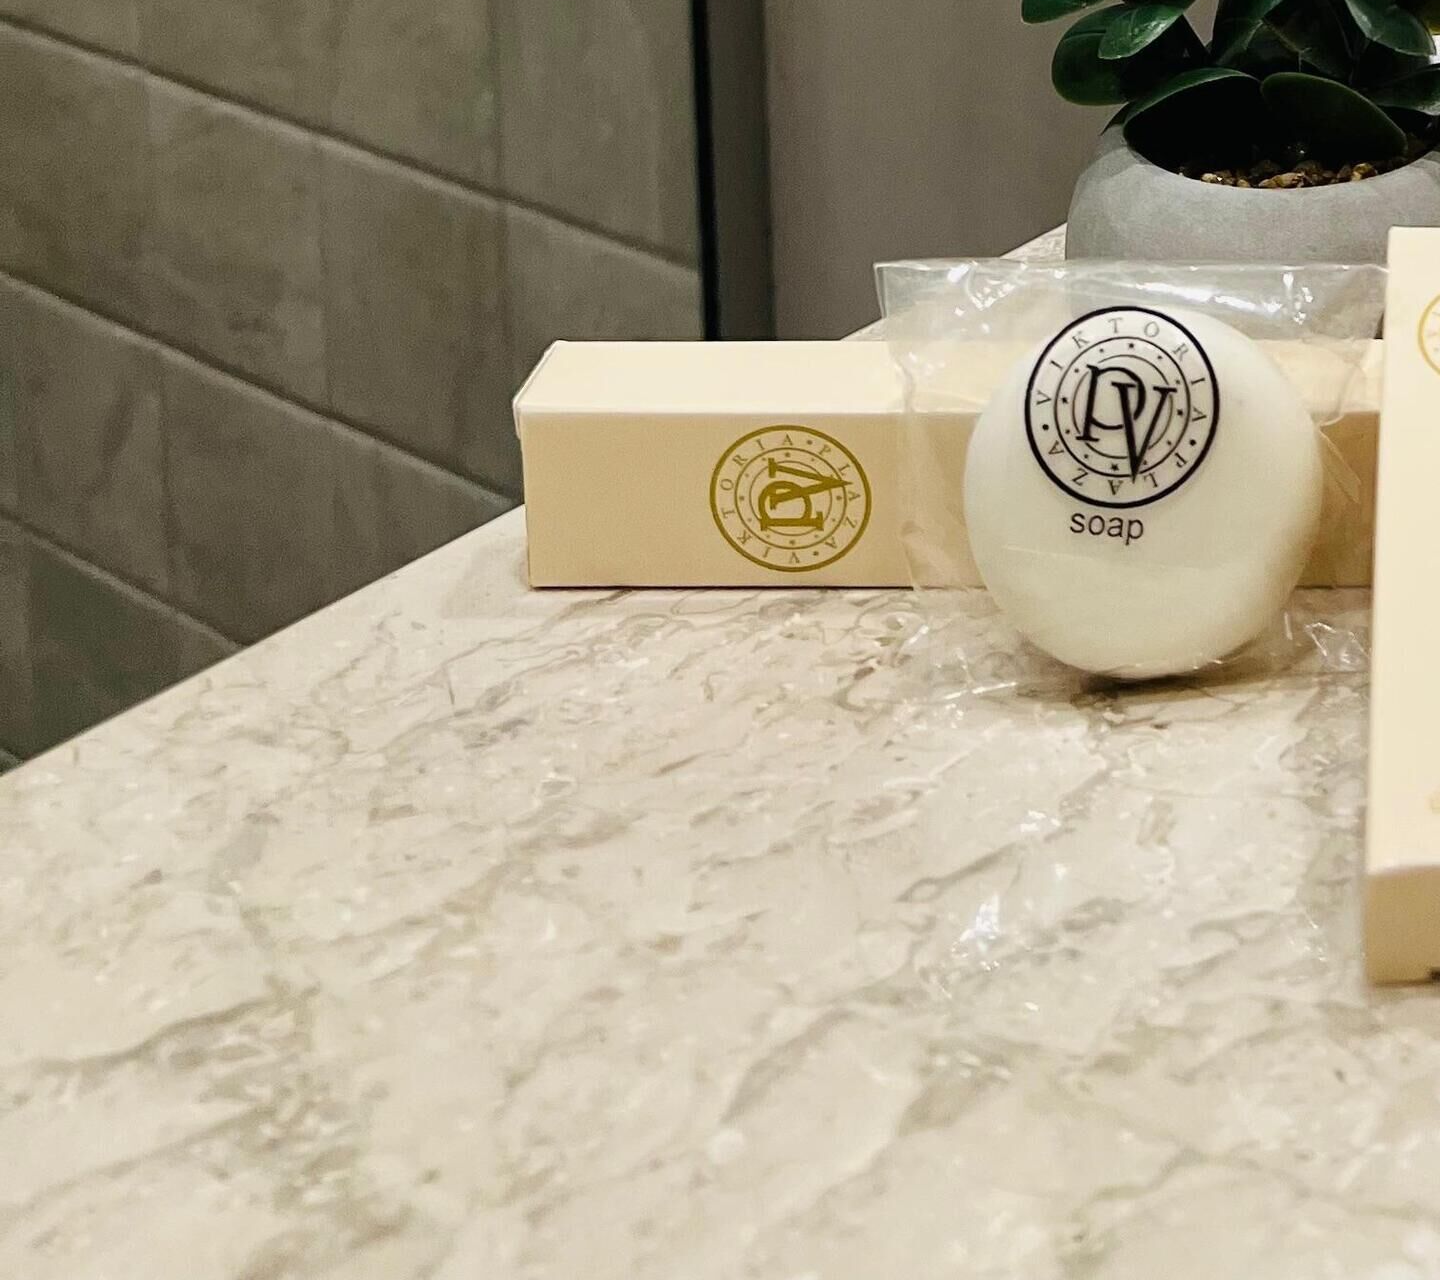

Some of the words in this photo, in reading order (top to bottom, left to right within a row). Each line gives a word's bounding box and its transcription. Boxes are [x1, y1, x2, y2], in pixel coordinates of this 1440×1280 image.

[1036, 317, 1207, 423] VIKTORIA
[1048, 440, 1189, 496] PLAZA
[1075, 363, 1178, 484] PV
[720, 434, 800, 564] VIKTORIA
[817, 443, 861, 550] PLAZA
[1069, 512, 1144, 545] soap
